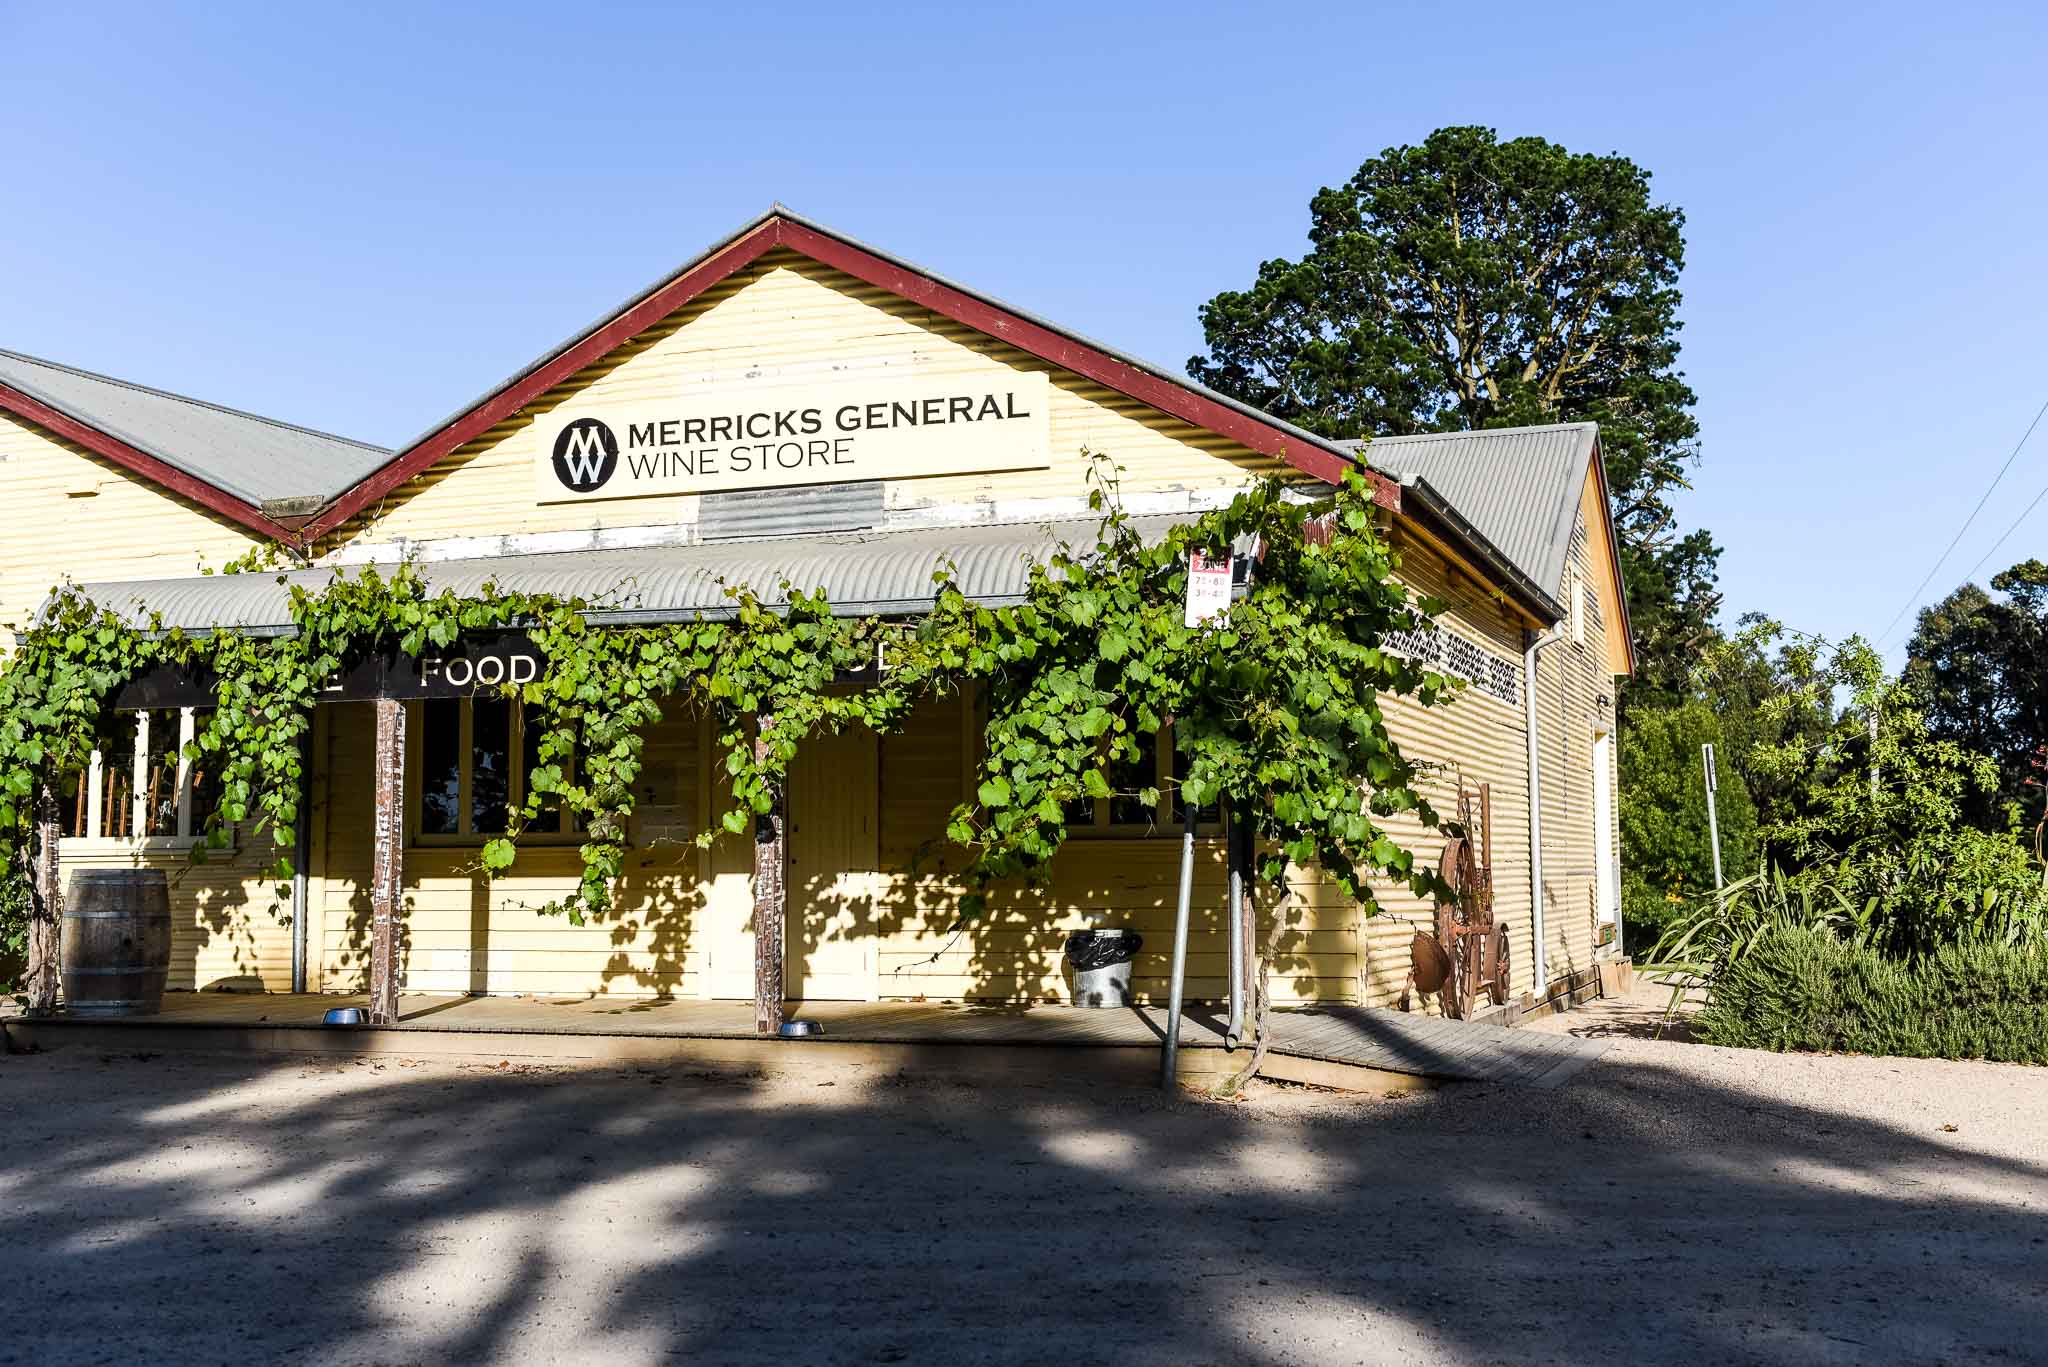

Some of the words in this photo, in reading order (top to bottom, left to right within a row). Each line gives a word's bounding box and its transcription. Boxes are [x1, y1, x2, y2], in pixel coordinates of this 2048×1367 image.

[629, 408, 822, 449] MERRICKS
[835, 392, 1030, 432] GENERAL
[627, 446, 719, 480] WINE
[729, 437, 855, 472] STORE
[420, 655, 537, 687] FOOD
